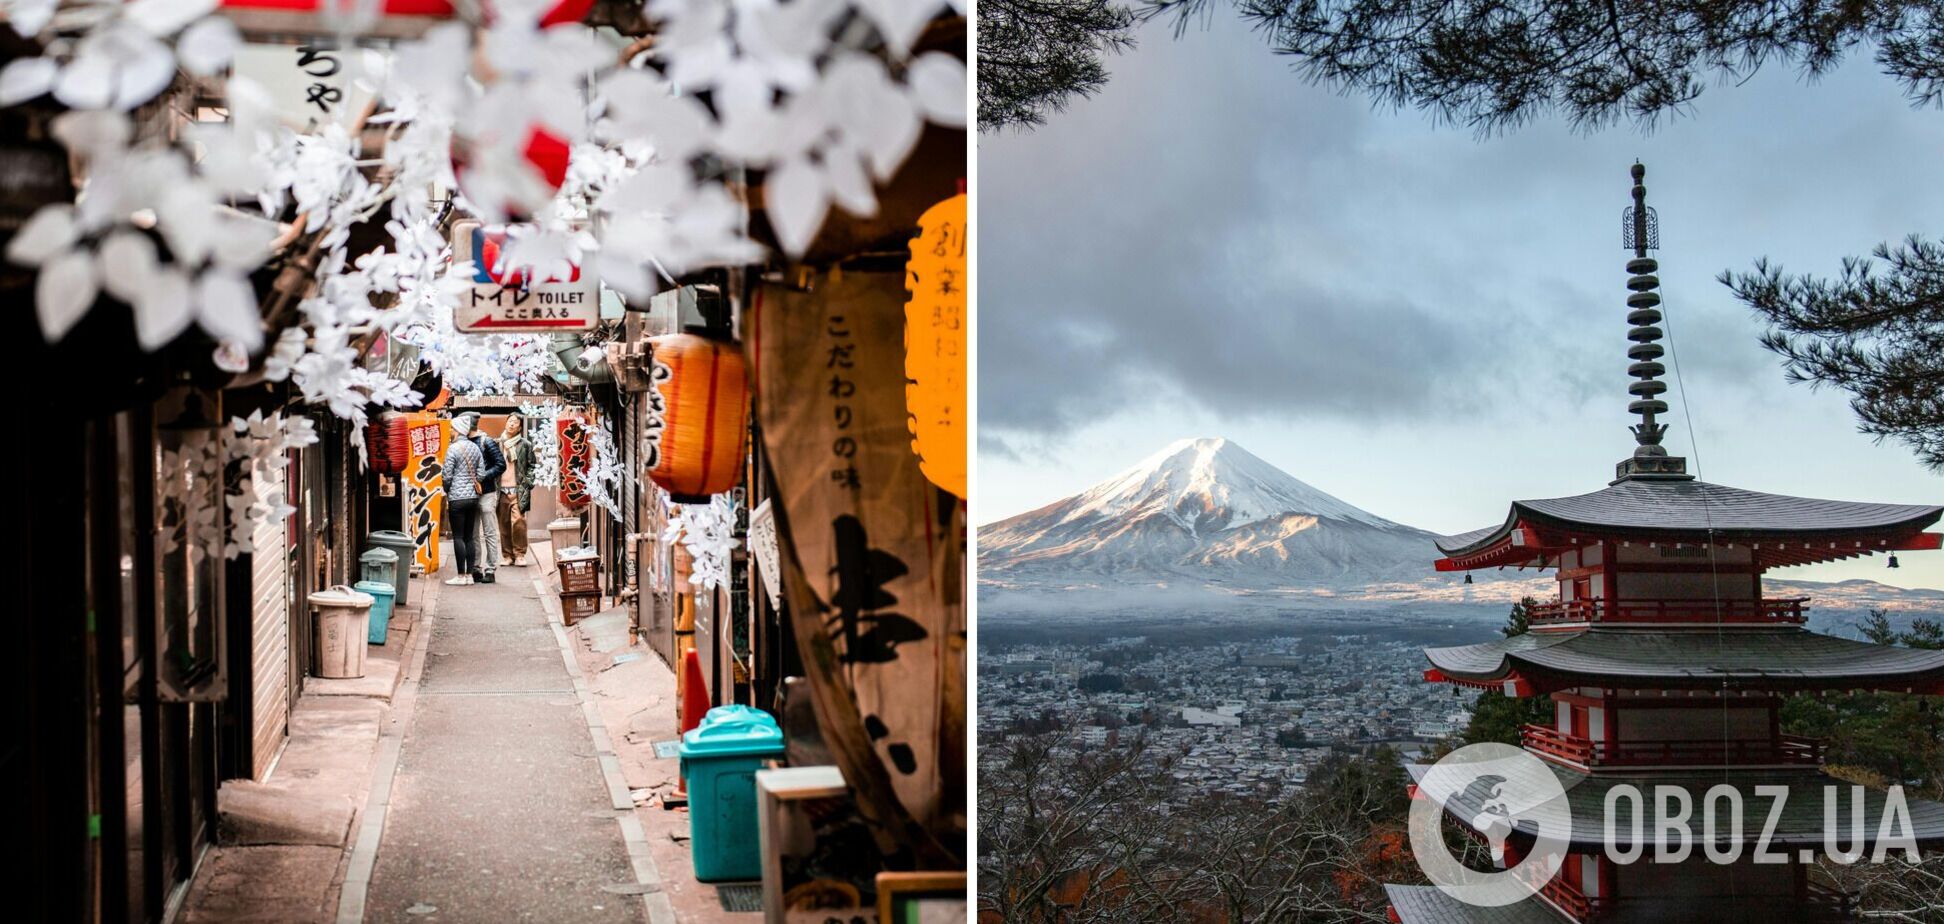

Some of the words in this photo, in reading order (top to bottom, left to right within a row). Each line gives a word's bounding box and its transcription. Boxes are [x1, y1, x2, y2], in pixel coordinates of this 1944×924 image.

[471, 284, 530, 308] トイレ
[537, 292, 585, 305] TOILET
[504, 308, 570, 319] ここ奥入る
[827, 315, 862, 490] こだわりの味
